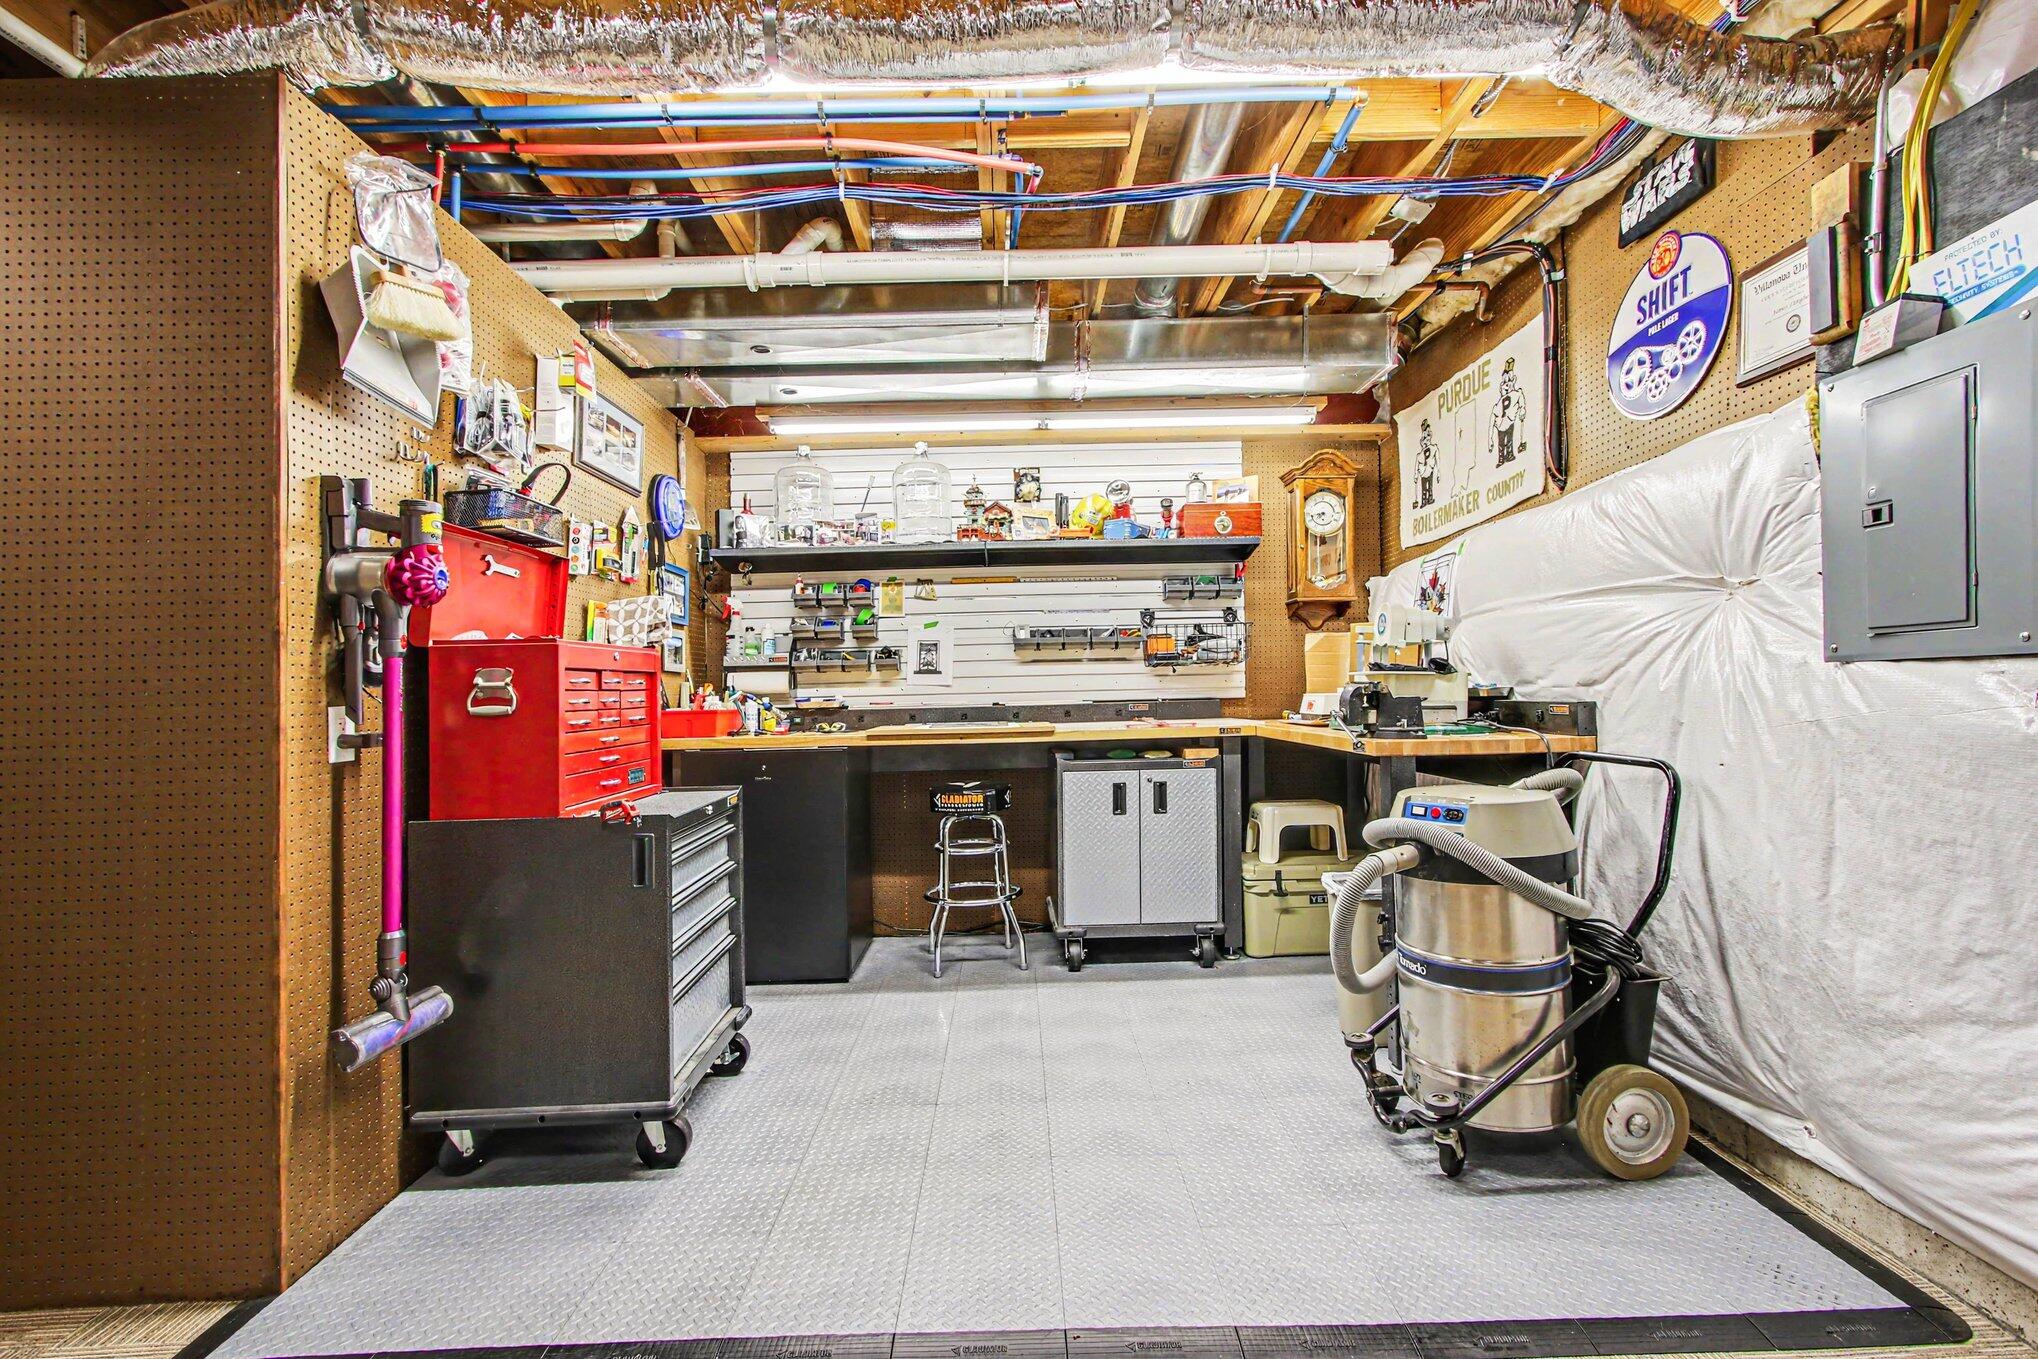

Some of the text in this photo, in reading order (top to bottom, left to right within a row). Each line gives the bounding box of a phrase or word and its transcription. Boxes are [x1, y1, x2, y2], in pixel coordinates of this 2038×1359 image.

[1620, 157, 1694, 235] WARS
[1621, 138, 1696, 214] STAR
[1944, 236, 1987, 261] PROTECTED
[1637, 265, 1692, 325] SHIFT
[1952, 286, 1979, 304] ECURITY
[1648, 321, 1663, 337] PALE
[1438, 358, 1492, 420] PURDUE
[1412, 470, 1525, 537] BOILERMAKER COUNTRY
[941, 794, 984, 804] GLADIATOR
